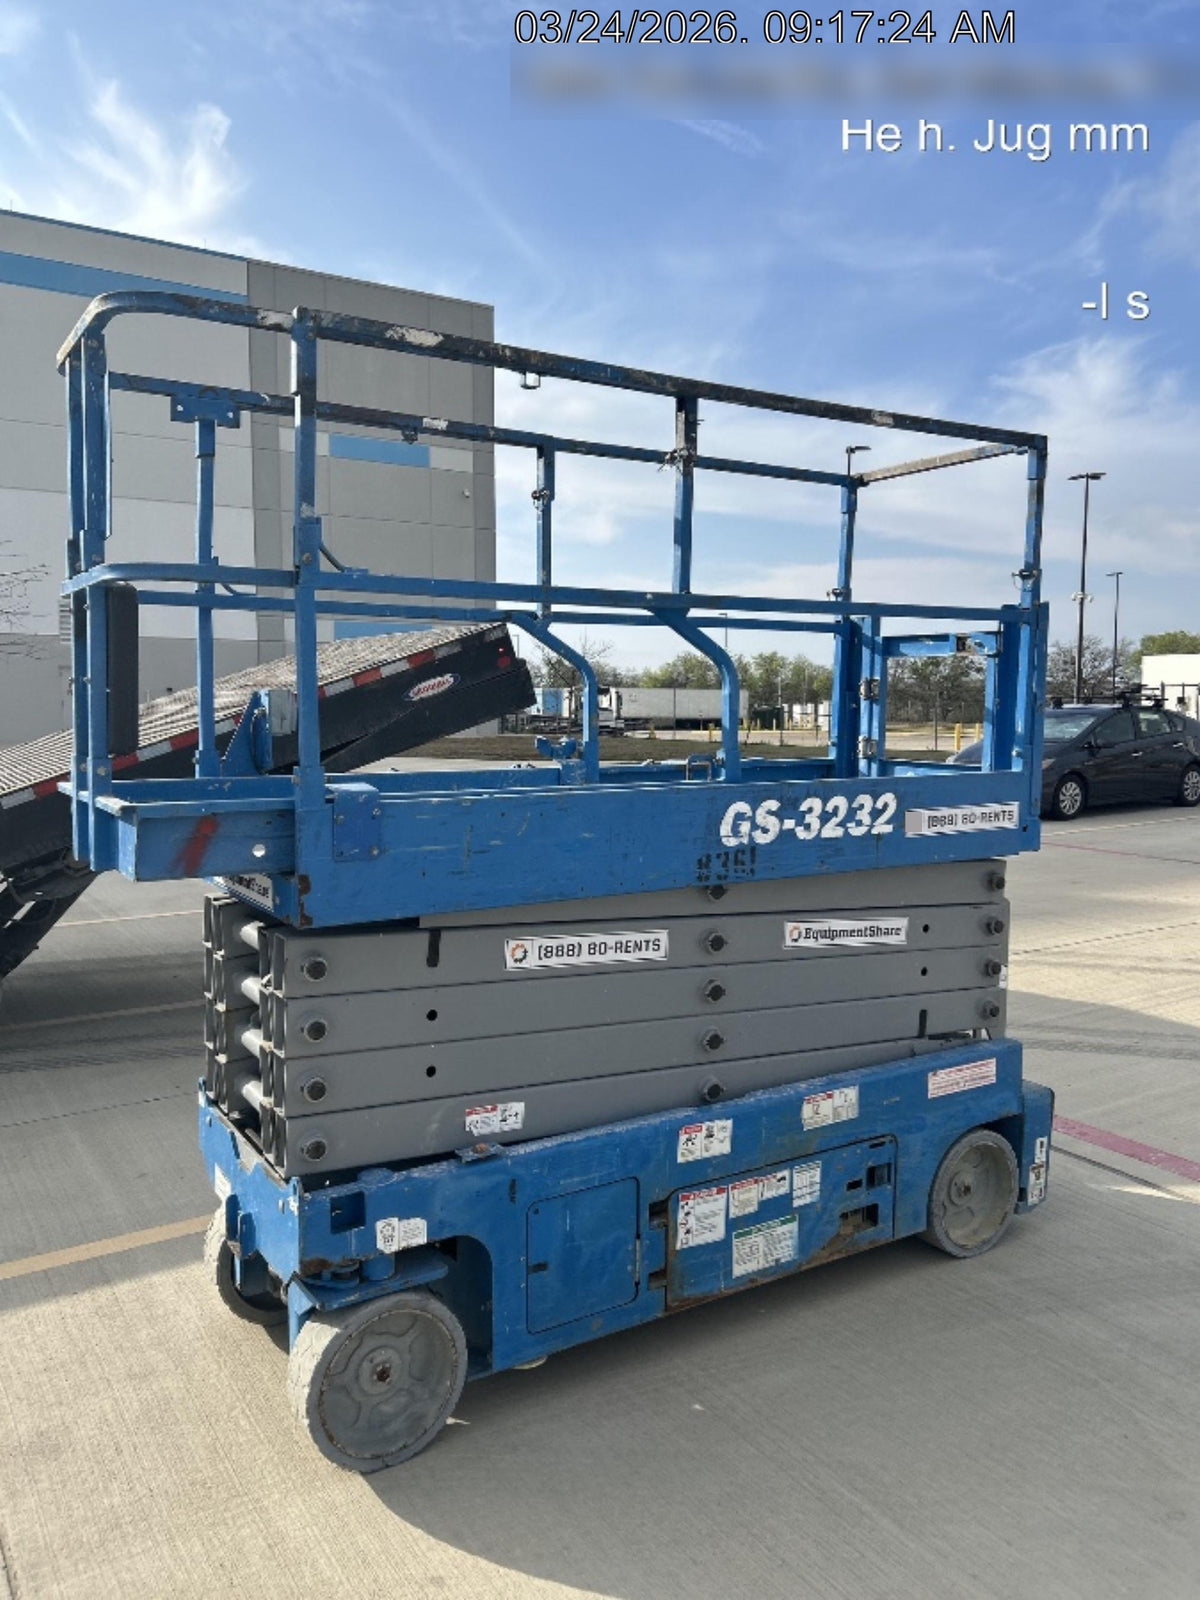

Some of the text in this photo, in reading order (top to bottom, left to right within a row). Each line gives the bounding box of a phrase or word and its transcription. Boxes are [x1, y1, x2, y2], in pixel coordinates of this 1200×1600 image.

[719, 792, 898, 847] GS-3232
[803, 925, 903, 943] EquipmentShare
[537, 941, 582, 961] (888)
